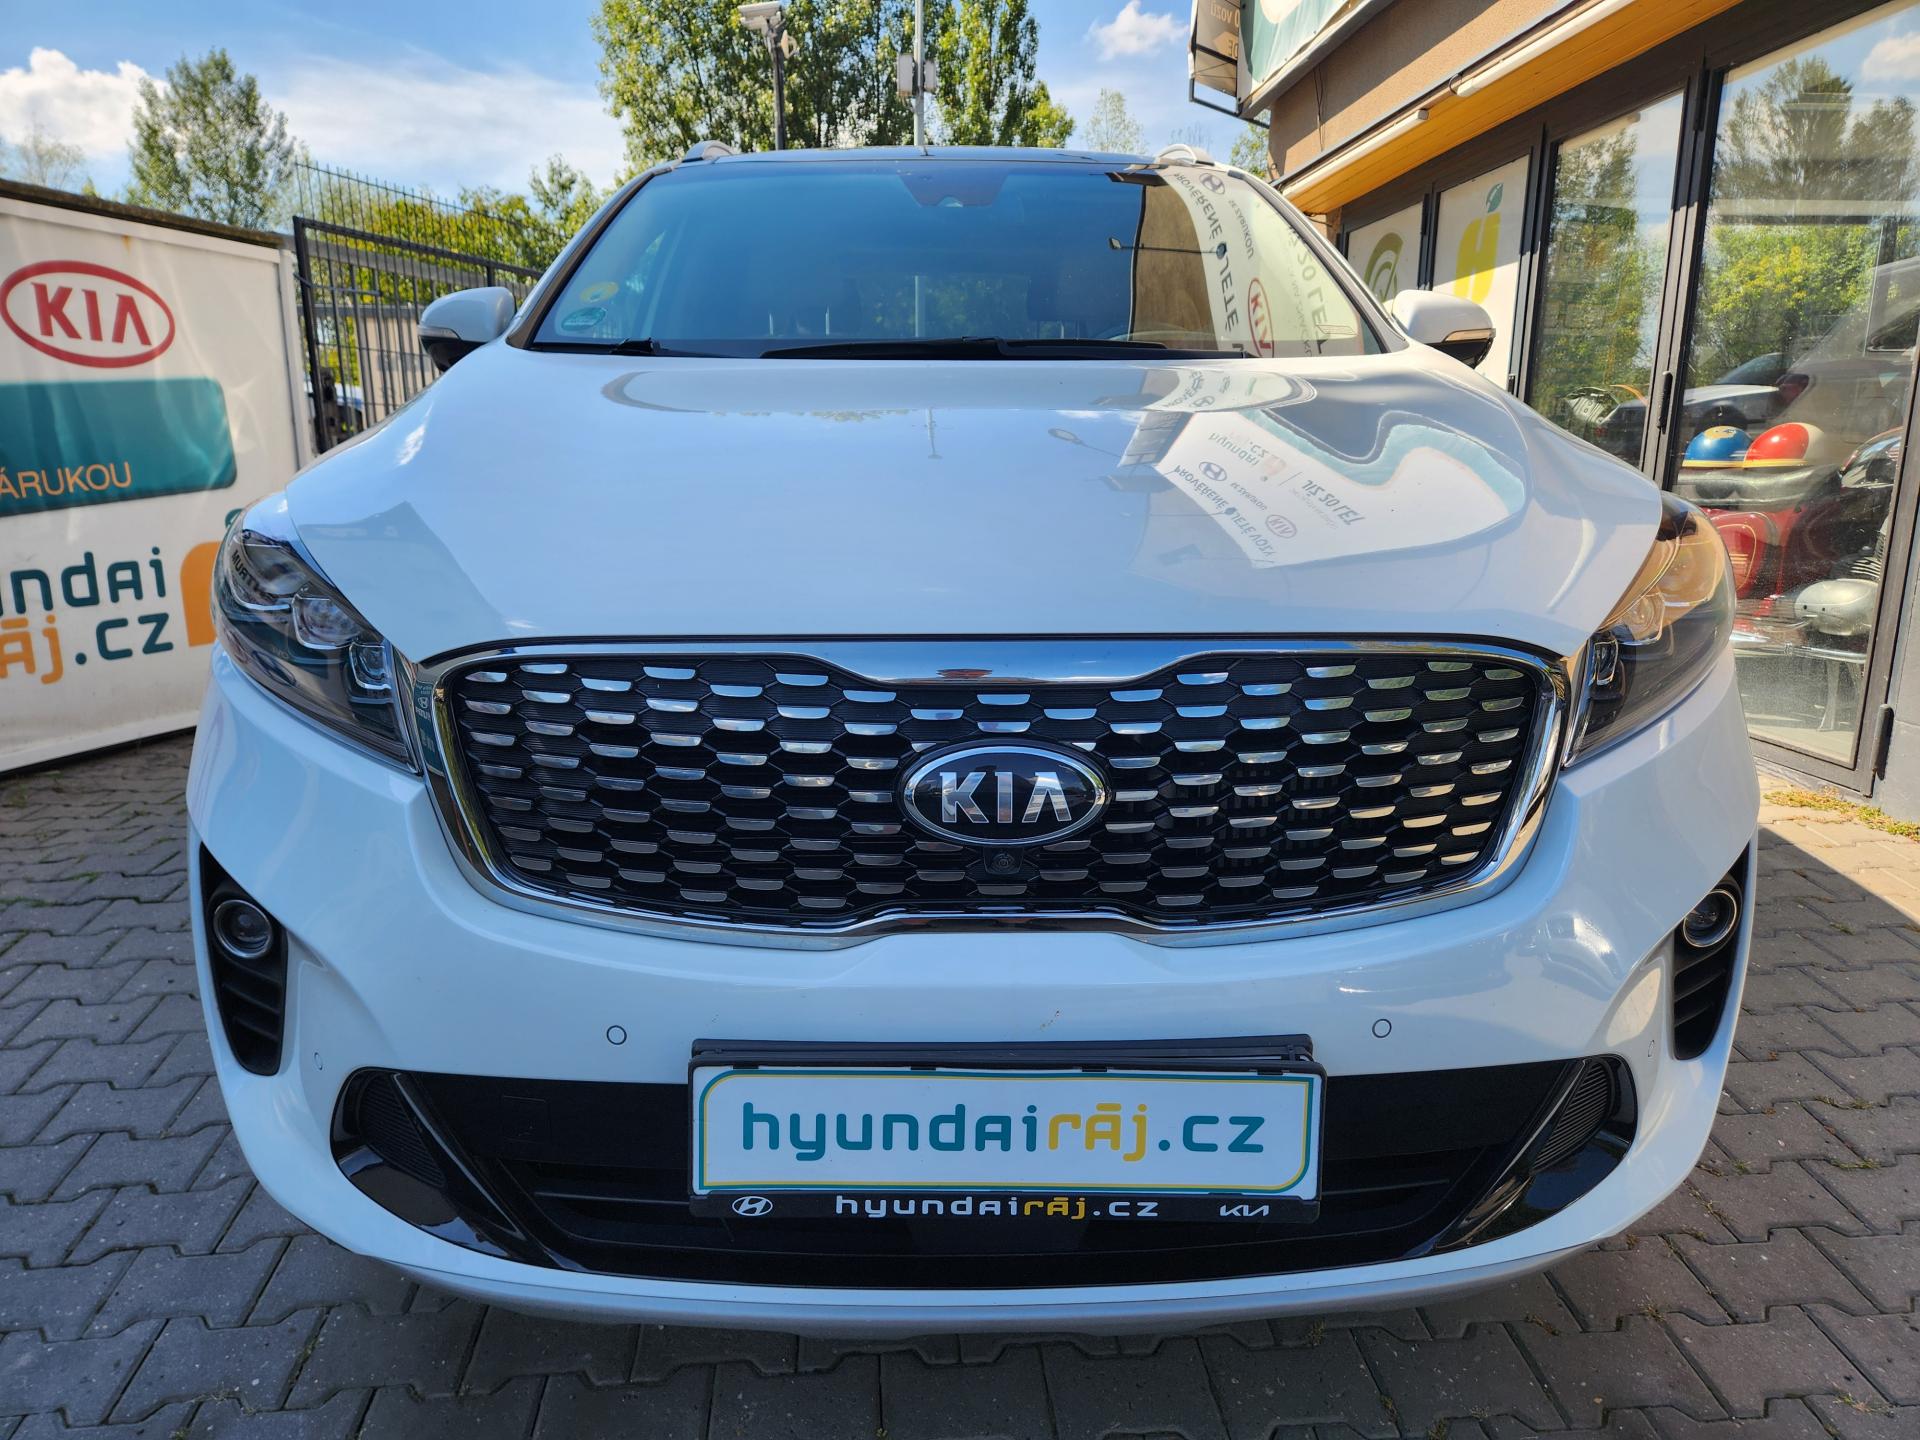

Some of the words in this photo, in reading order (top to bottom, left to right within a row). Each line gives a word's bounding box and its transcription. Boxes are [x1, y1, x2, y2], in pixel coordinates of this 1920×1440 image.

[30, 281, 152, 346] KIA
[0, 546, 167, 617] ndai
[939, 771, 1073, 824] KIA
